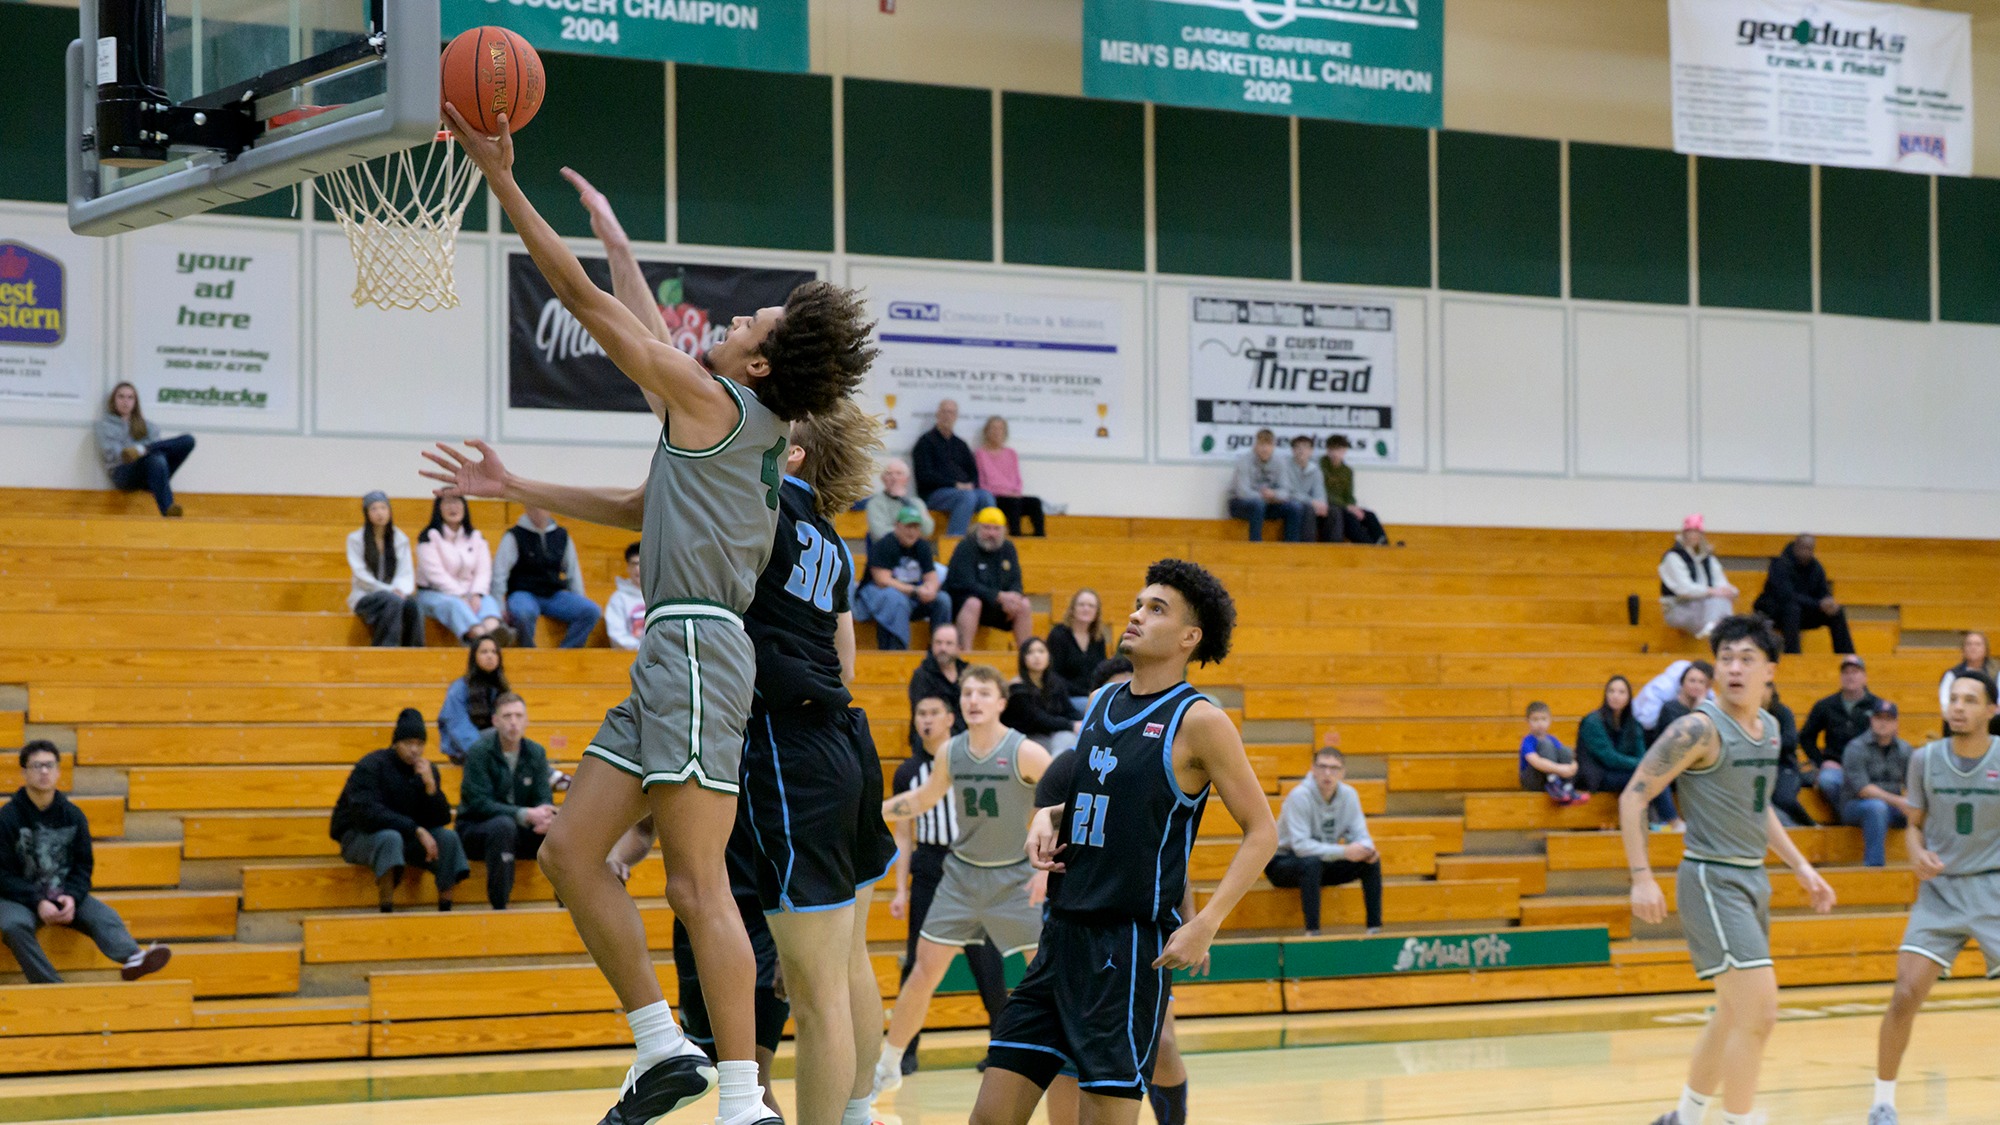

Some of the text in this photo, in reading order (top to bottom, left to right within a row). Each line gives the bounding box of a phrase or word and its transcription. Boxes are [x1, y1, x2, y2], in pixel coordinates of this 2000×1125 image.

[623, 0, 759, 30] CHAMPION
[560, 16, 619, 44] 2004
[1180, 26, 1352, 59] CASCADE CONFERENCE
[488, 41, 508, 115] SPALDING
[1100, 39, 1432, 94] MEN'S BASKETBALL CHAMPION
[1766, 54, 1887, 76] track & field
[1242, 79, 1292, 104] 2002
[176, 252, 253, 274] your
[0, 278, 37, 306] est
[195, 279, 235, 299] ad
[0, 304, 60, 331] stern
[176, 305, 251, 330] here
[889, 302, 940, 321] CTM
[157, 345, 208, 356] contact
[1266, 335, 1354, 351] a custom
[1018, 373, 1102, 386] TROPHIES
[1256, 354, 1372, 394] Thread
[157, 386, 268, 405] geoducks
[760, 436, 787, 511] 4
[784, 520, 842, 613] 30
[963, 787, 999, 817] 24
[1071, 792, 1110, 848] 21
[1955, 803, 1974, 835] 0
[1418, 933, 1511, 968] Mud Pit
